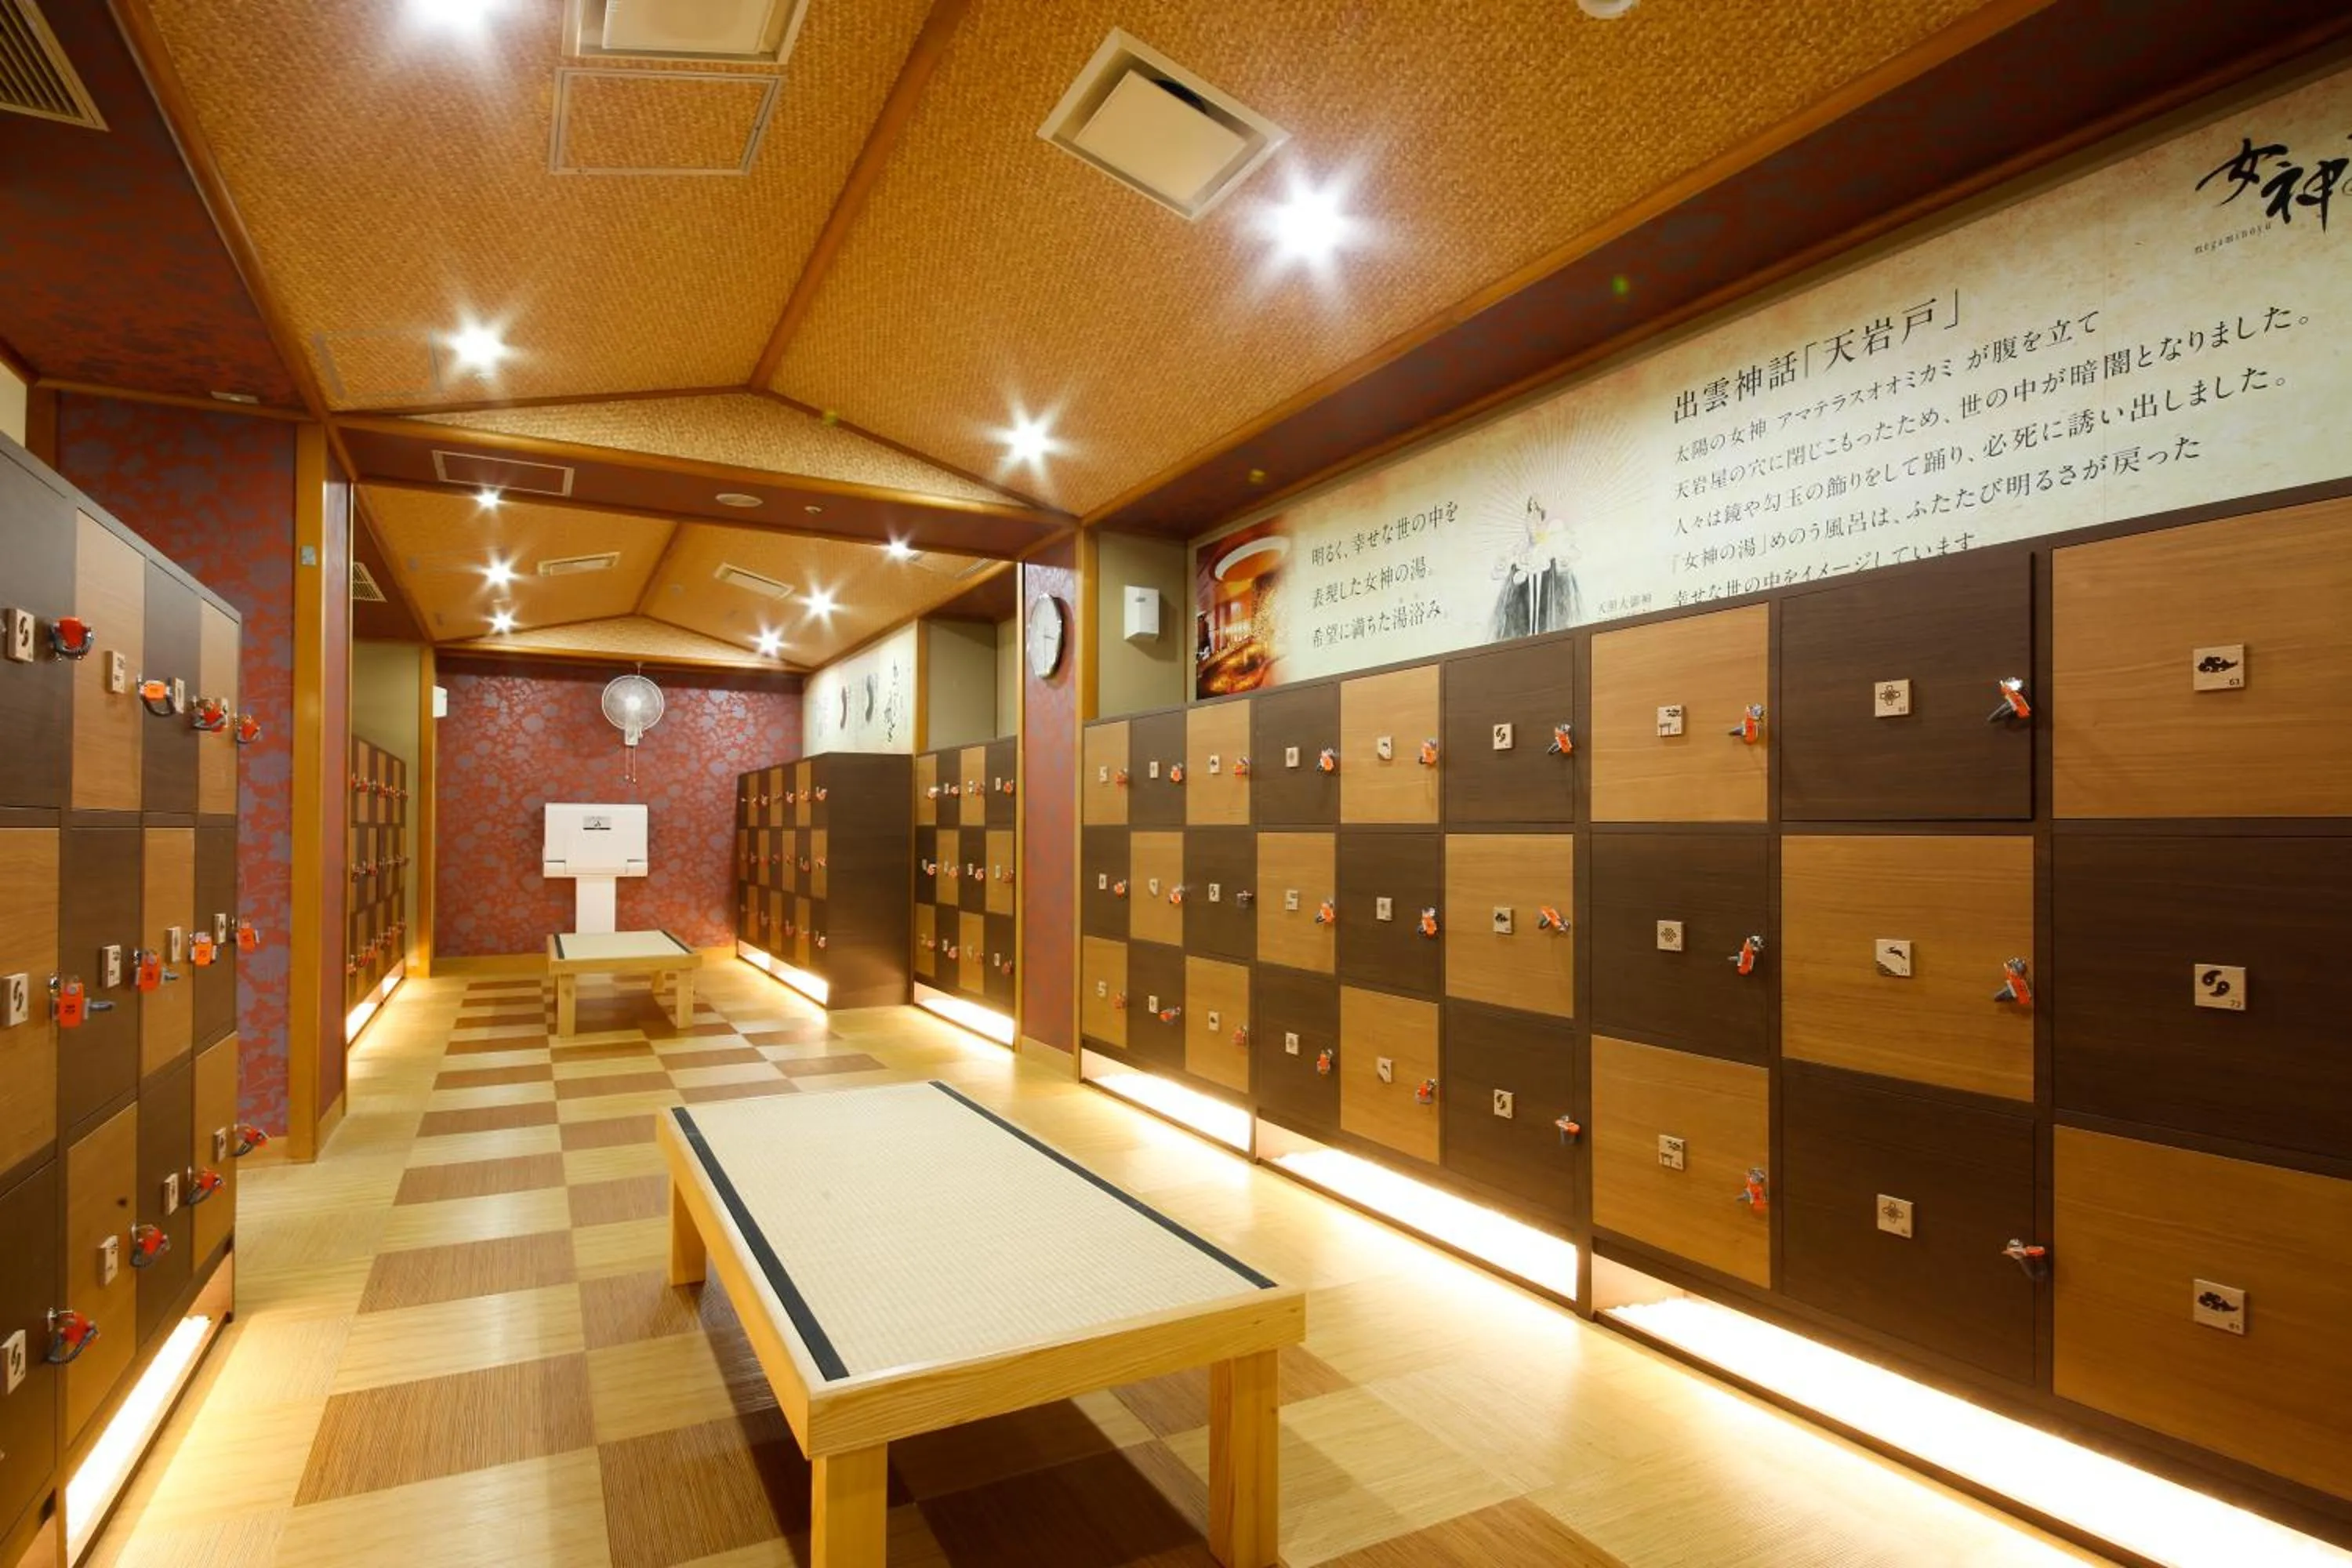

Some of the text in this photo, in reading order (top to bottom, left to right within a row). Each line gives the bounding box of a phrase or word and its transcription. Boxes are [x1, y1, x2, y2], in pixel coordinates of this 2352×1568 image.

[2195, 133, 2352, 234] 女神
[1674, 288, 1959, 424] 出雲神話「天岩戸」
[1674, 310, 2100, 466] 太陽の女神 アマテラスオオミカミ が腹を立て
[1312, 501, 1458, 566] 明るく、幸せな世の中を
